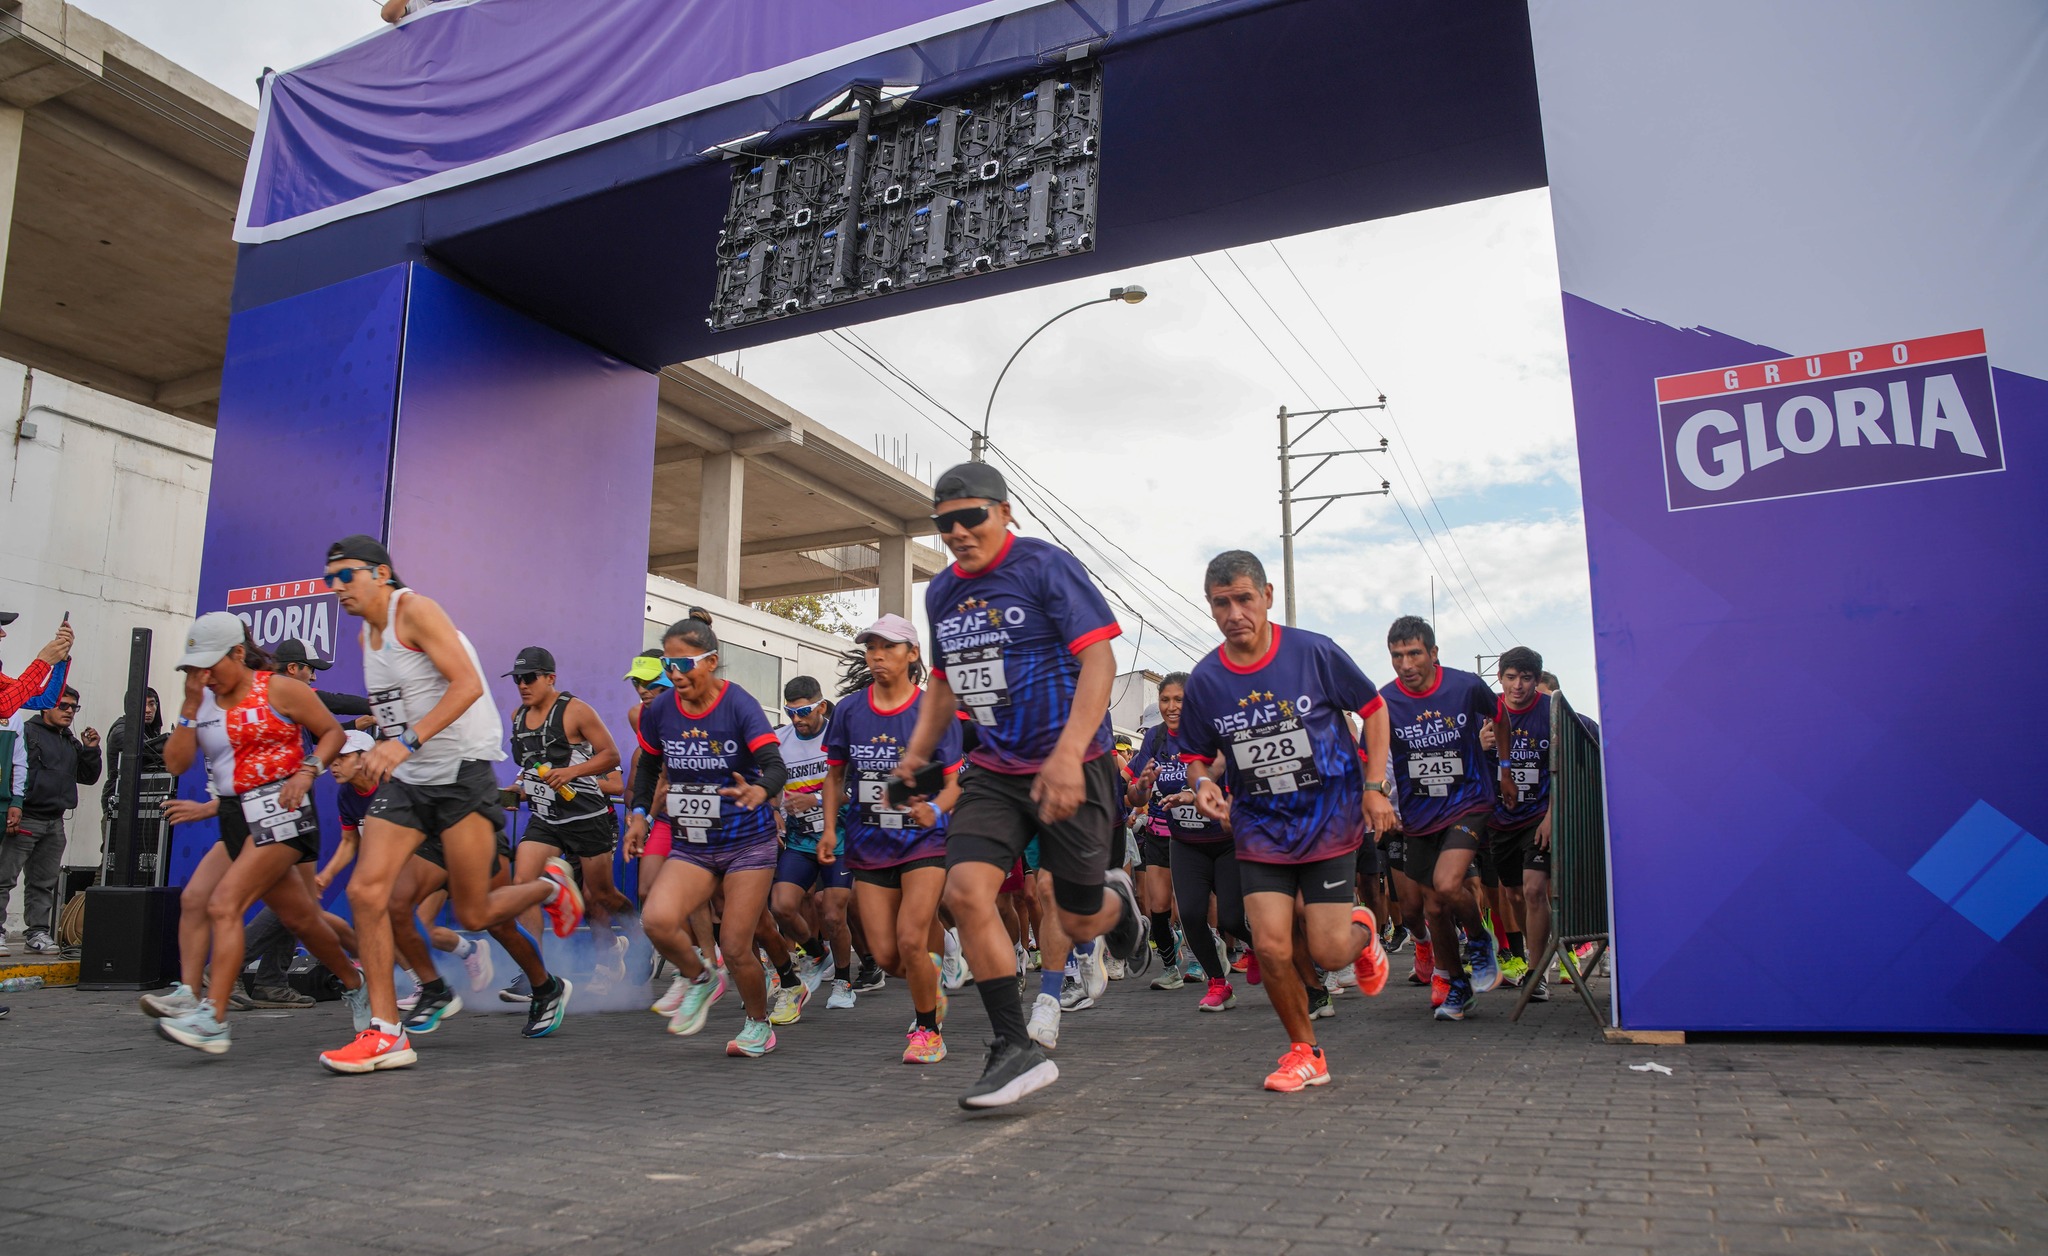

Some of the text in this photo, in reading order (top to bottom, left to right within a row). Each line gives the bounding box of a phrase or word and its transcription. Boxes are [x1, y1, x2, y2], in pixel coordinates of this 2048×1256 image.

[1724, 344, 1908, 391] GRUPO
[1675, 373, 1988, 492] GLORIA
[251, 581, 315, 601] GRUPO
[958, 667, 992, 690] 275
[1279, 718, 1299, 732] 21K
[1408, 729, 1461, 750] AREQUIPA
[1248, 738, 1296, 764] 228
[667, 757, 729, 772] AREQUIPA
[1418, 761, 1453, 776] 245
[533, 784, 546, 797] 69
[263, 798, 276, 814] 5
[679, 798, 711, 815] 299
